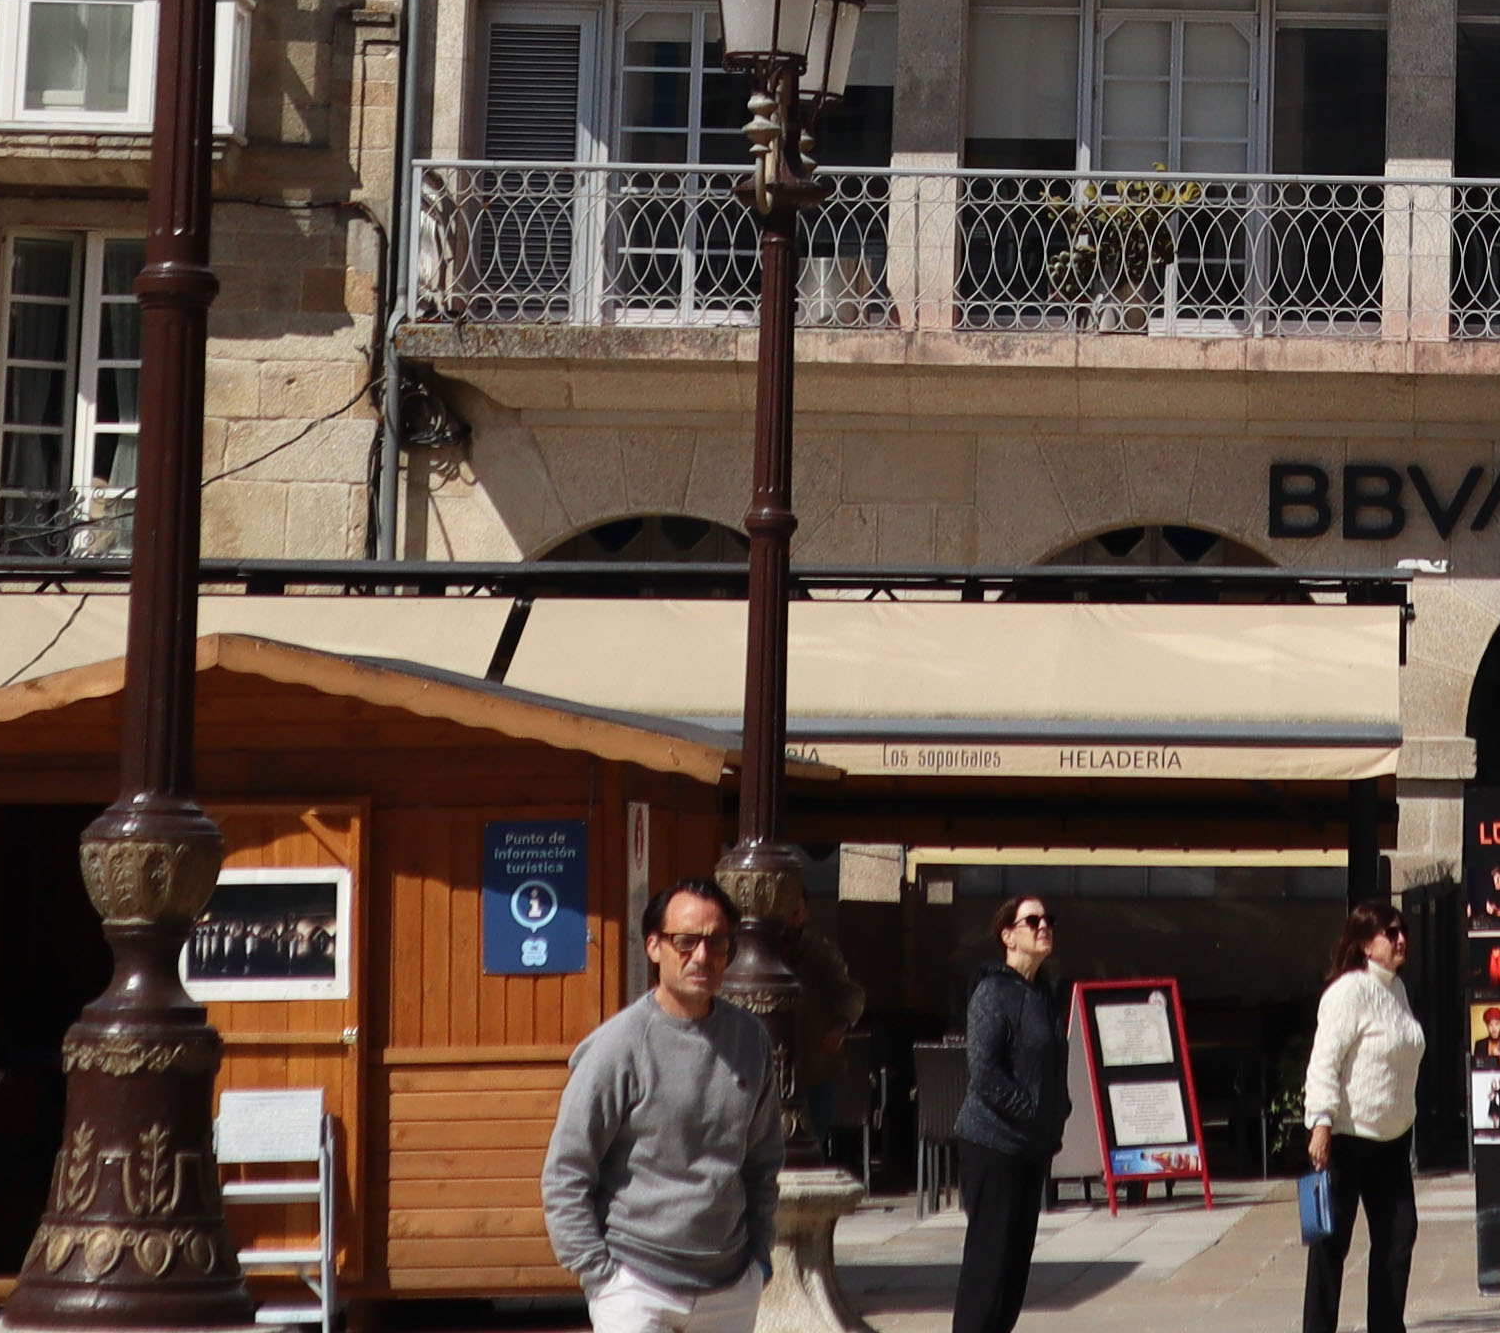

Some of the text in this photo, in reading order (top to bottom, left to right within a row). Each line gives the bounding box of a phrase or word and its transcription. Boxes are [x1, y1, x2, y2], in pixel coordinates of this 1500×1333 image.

[917, 746, 1001, 773] soportales
[1059, 744, 1183, 769] HELADERÍA
[505, 831, 565, 846] Punto de
[494, 845, 576, 860] información
